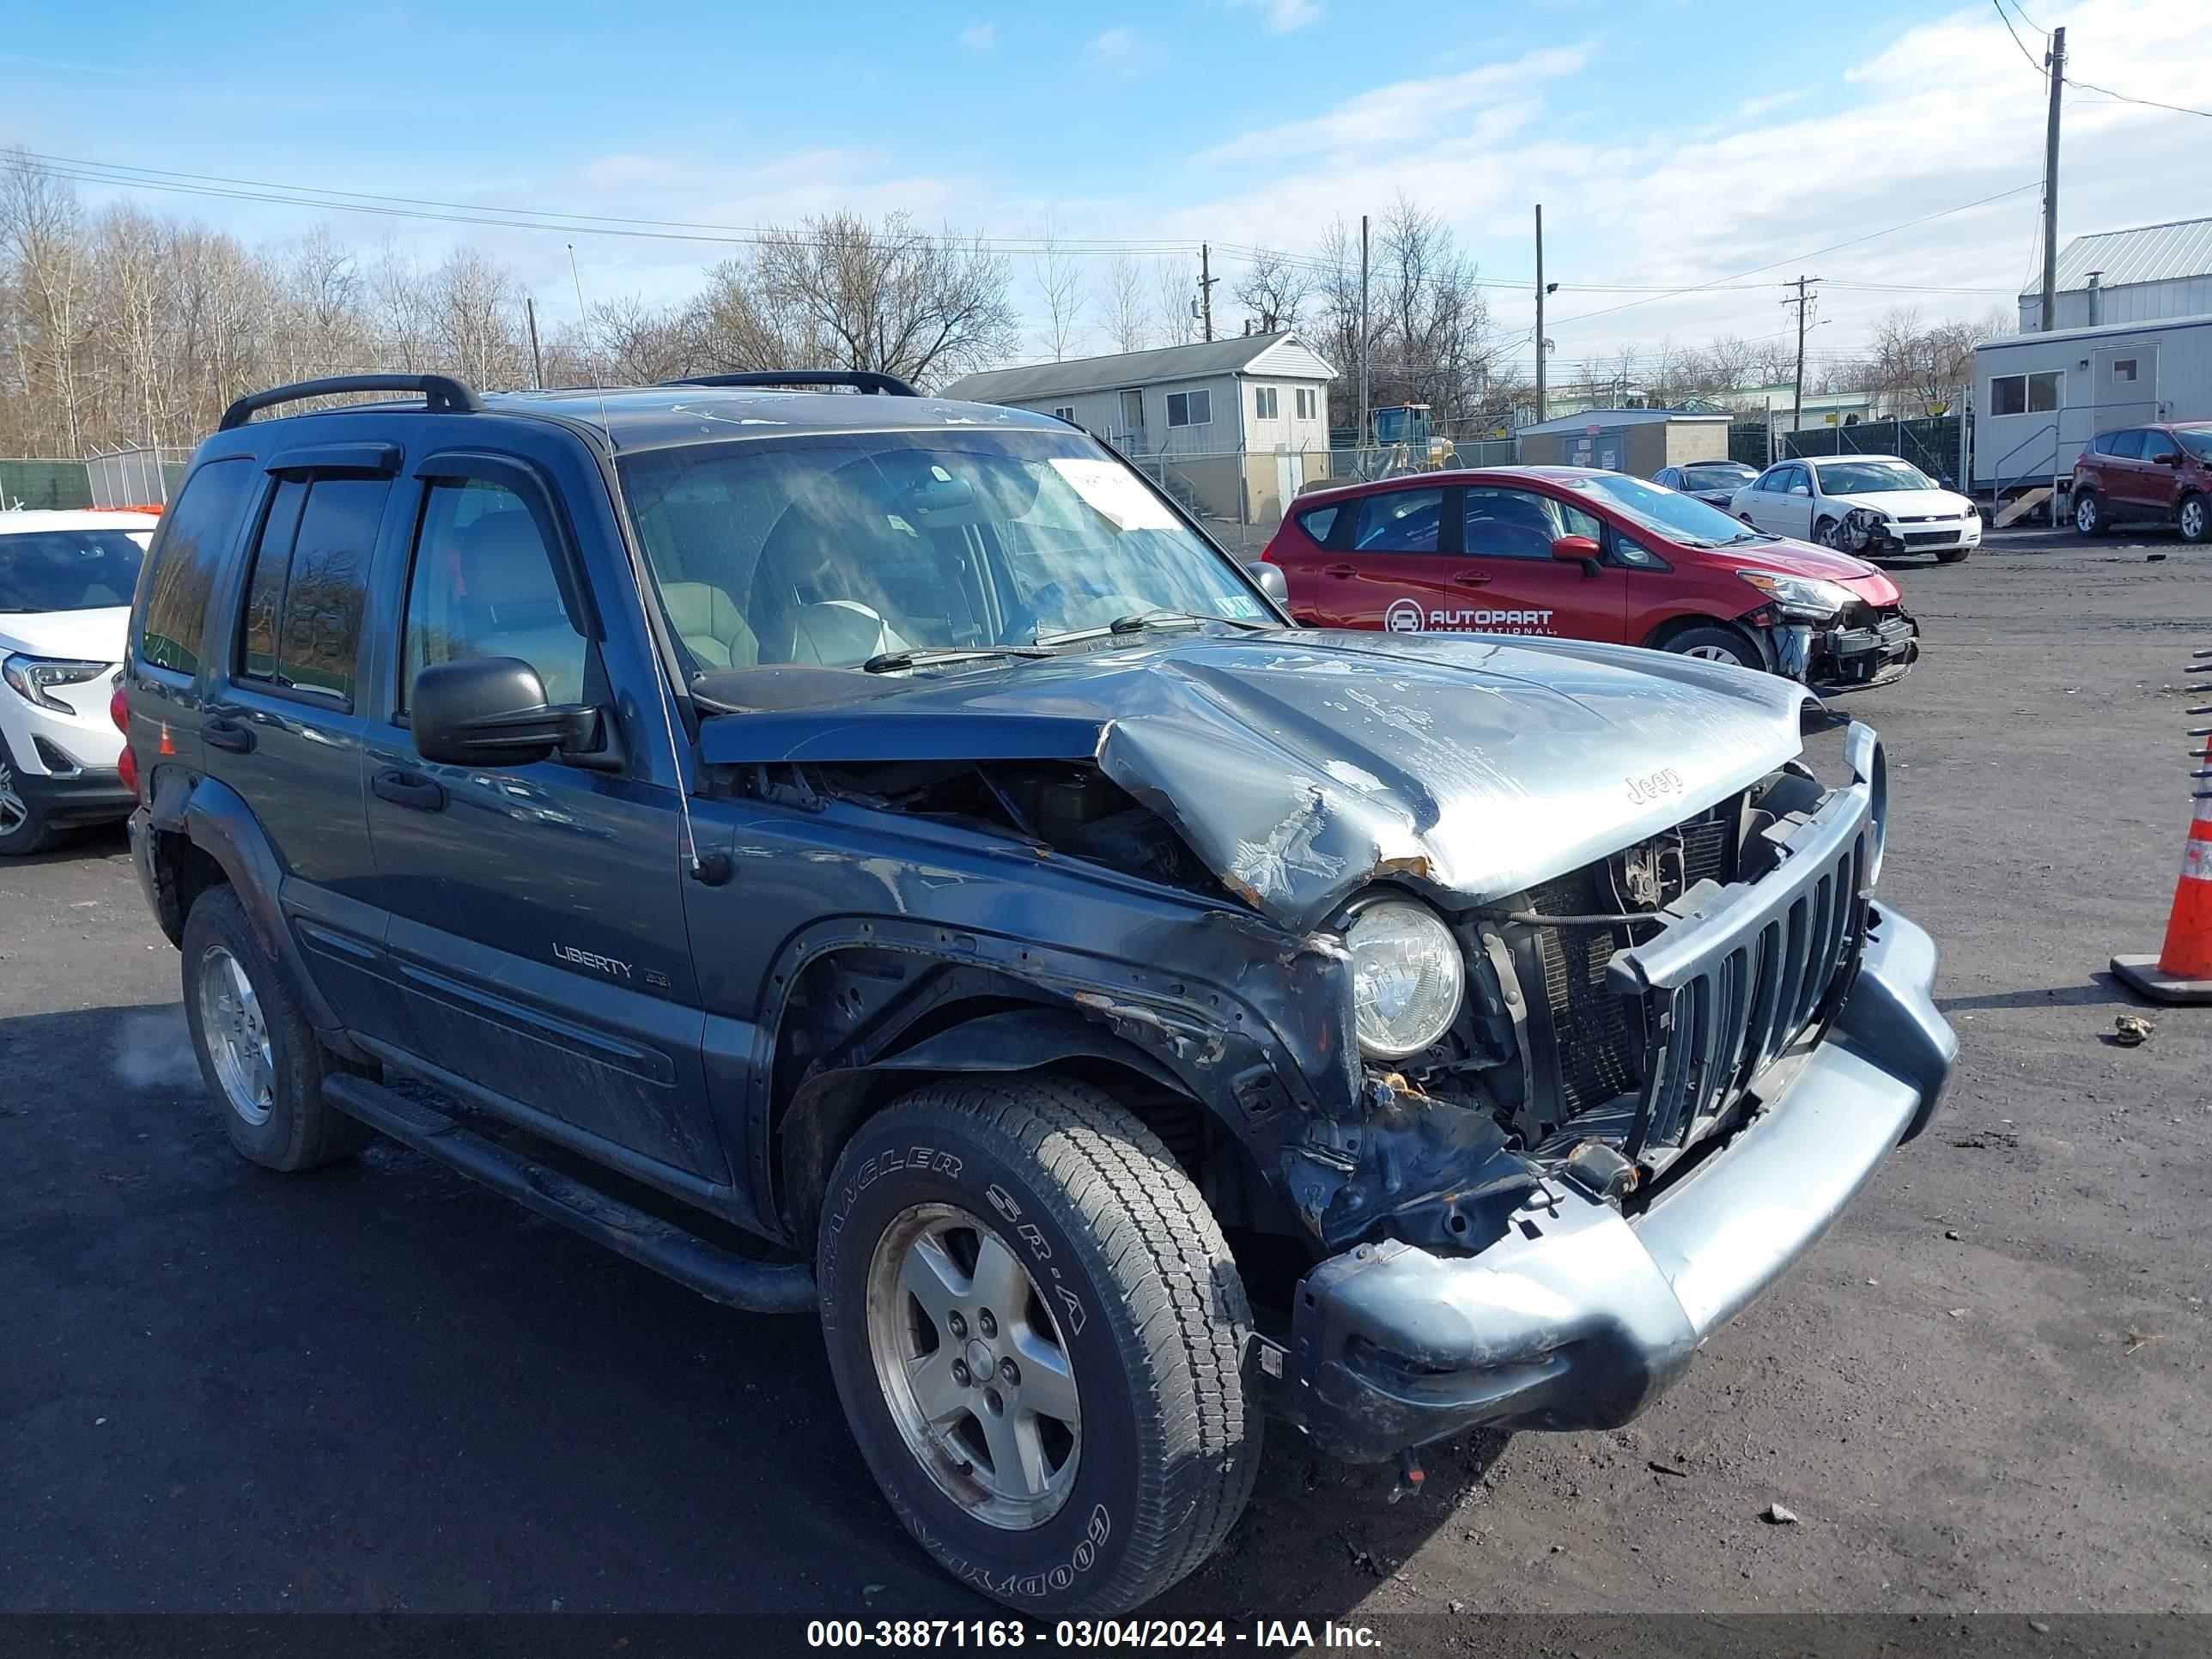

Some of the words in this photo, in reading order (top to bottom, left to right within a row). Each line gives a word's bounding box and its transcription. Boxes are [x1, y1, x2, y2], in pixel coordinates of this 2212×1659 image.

[1430, 610, 1553, 625] AUTOPART
[1625, 768, 1684, 805] Jeep
[552, 942, 633, 979] LIBERTY
